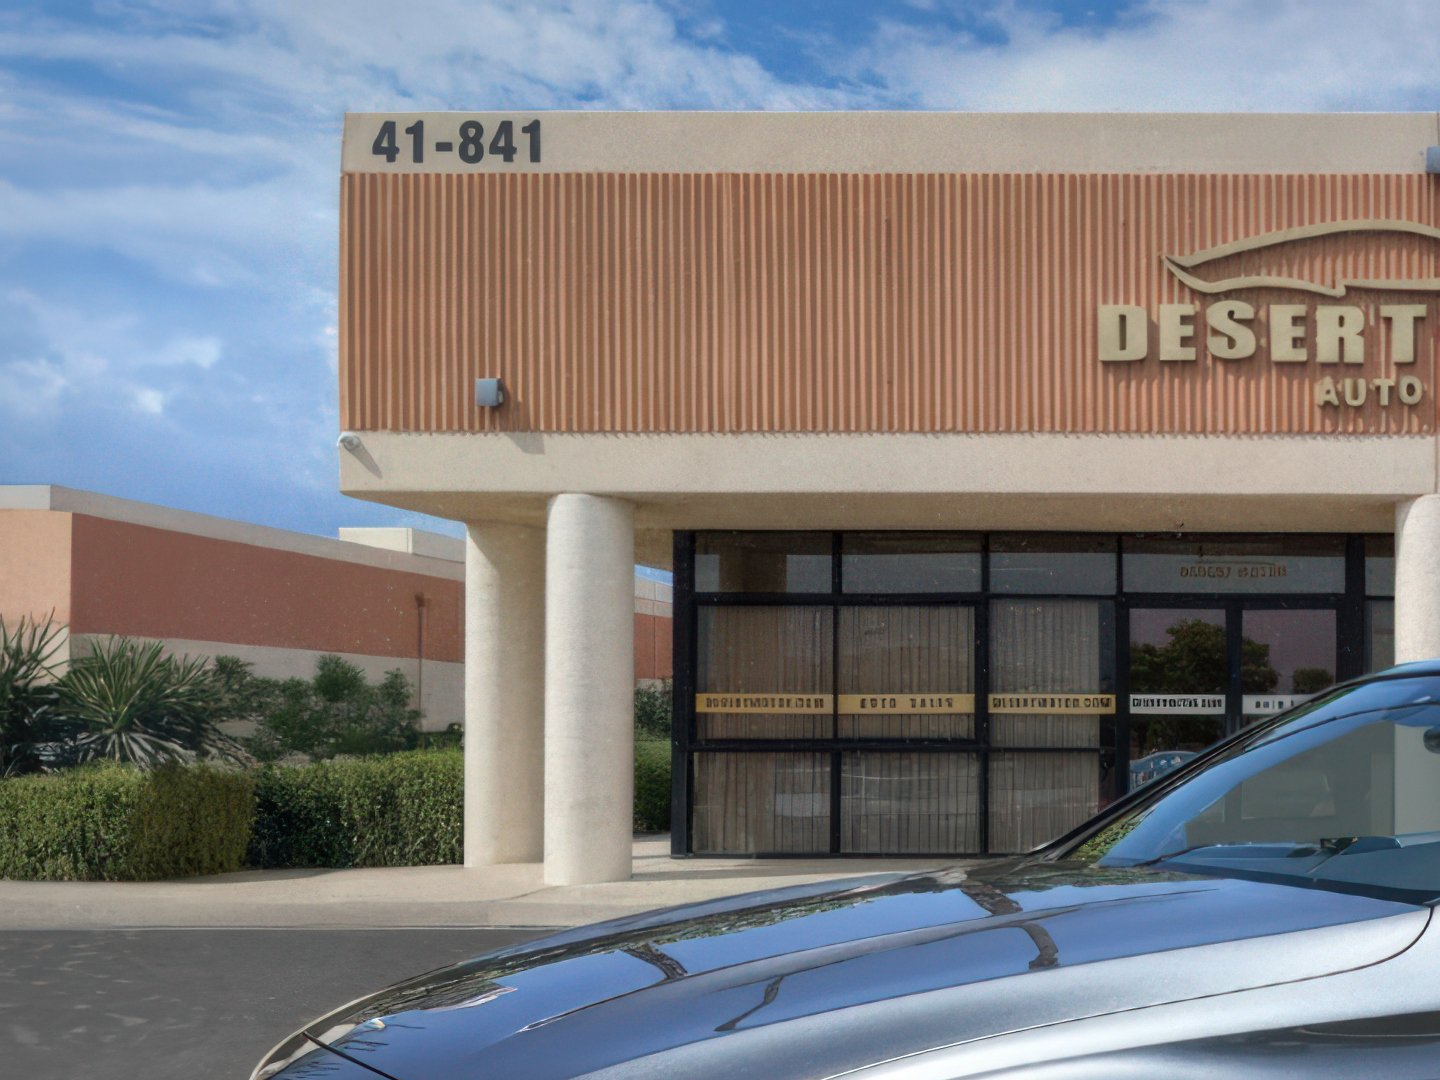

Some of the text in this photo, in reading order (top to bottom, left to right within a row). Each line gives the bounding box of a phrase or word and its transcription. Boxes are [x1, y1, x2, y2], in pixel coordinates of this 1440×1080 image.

[371, 118, 542, 165] 41-841
[1098, 299, 1428, 364] DESERT
[1315, 374, 1424, 408] AUTO
